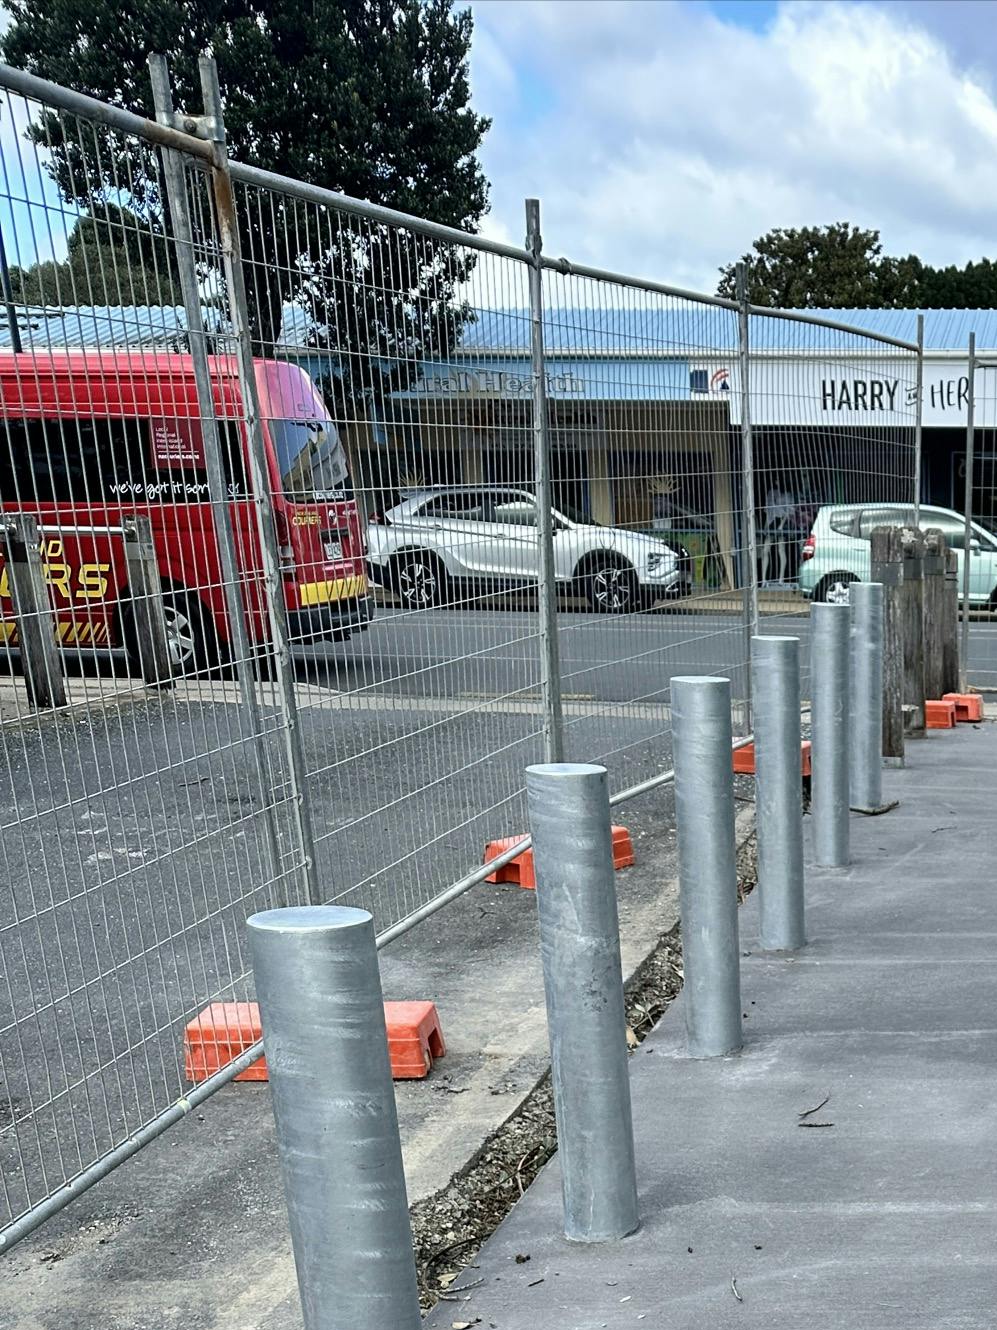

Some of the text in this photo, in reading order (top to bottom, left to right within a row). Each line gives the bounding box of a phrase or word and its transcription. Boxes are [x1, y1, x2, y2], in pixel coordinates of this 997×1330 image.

[822, 379, 898, 411] HARRY
[931, 376, 971, 411] HER
[109, 481, 143, 494] we've
[146, 481, 169, 499] got
[172, 480, 182, 494] it
